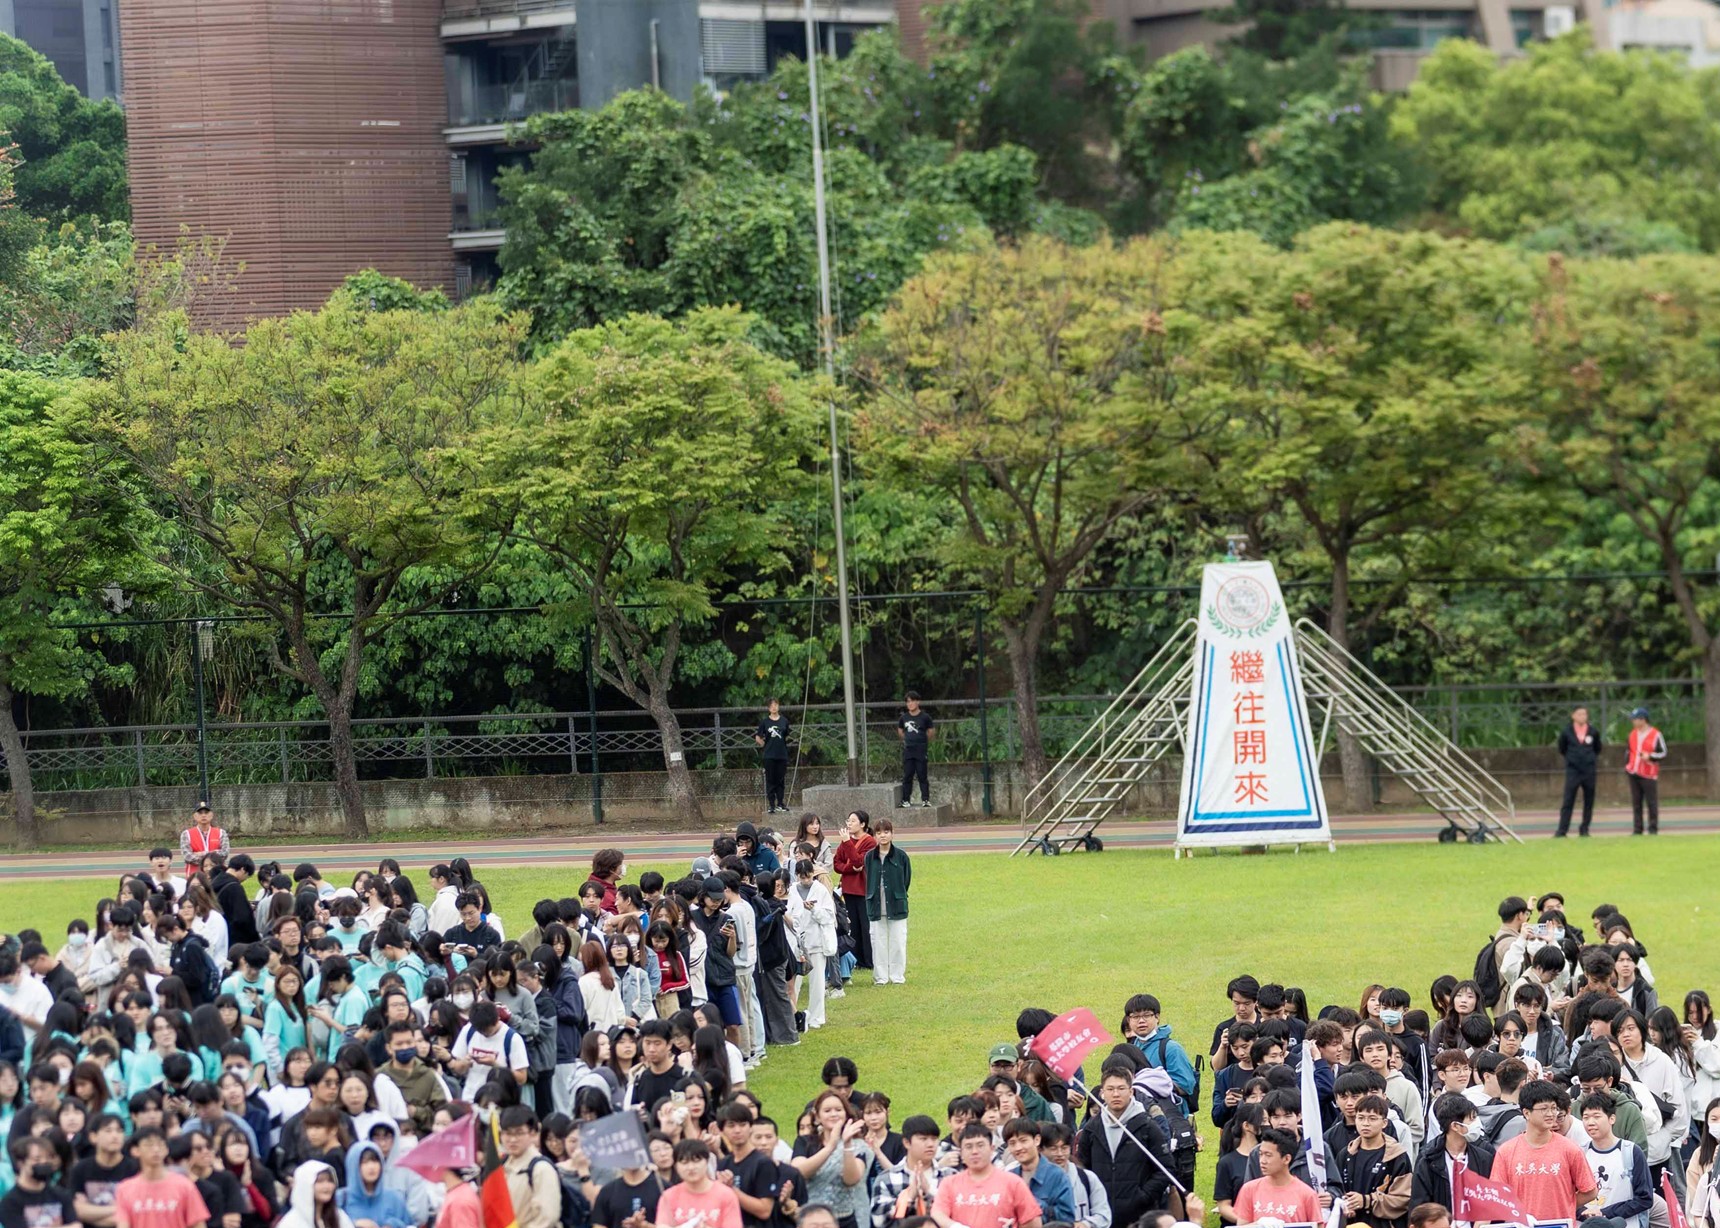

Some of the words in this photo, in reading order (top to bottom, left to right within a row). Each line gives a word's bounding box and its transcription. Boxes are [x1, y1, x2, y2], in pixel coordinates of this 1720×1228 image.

[1230, 650, 1269, 806] 繼往開來
[1515, 1160, 1561, 1176] 東吳大學
[955, 1192, 1000, 1206] 東吳大學
[1252, 1200, 1298, 1218] 東吳大學
